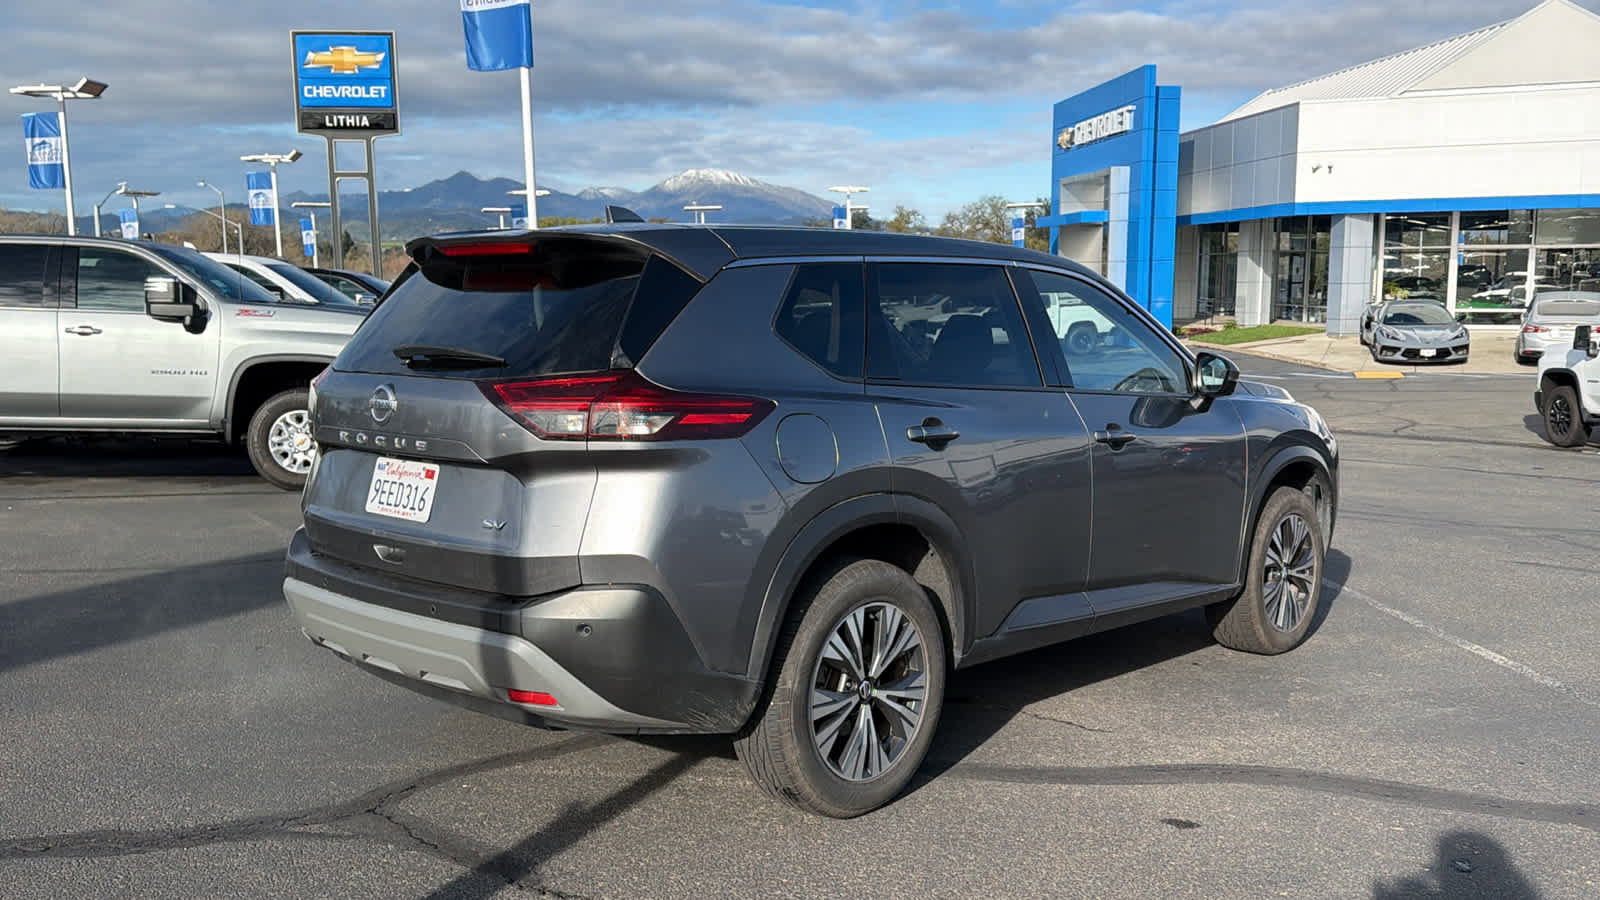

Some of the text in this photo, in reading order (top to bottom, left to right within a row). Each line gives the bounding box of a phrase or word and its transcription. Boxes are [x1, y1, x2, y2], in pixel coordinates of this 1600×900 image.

[303, 85, 387, 98] CHEVROLET
[325, 115, 370, 127] LITHIA
[1074, 105, 1136, 145] CHEVROLET
[340, 431, 427, 451] ROGUE
[370, 478, 430, 512] 9EED316
[482, 519, 507, 530] SV
